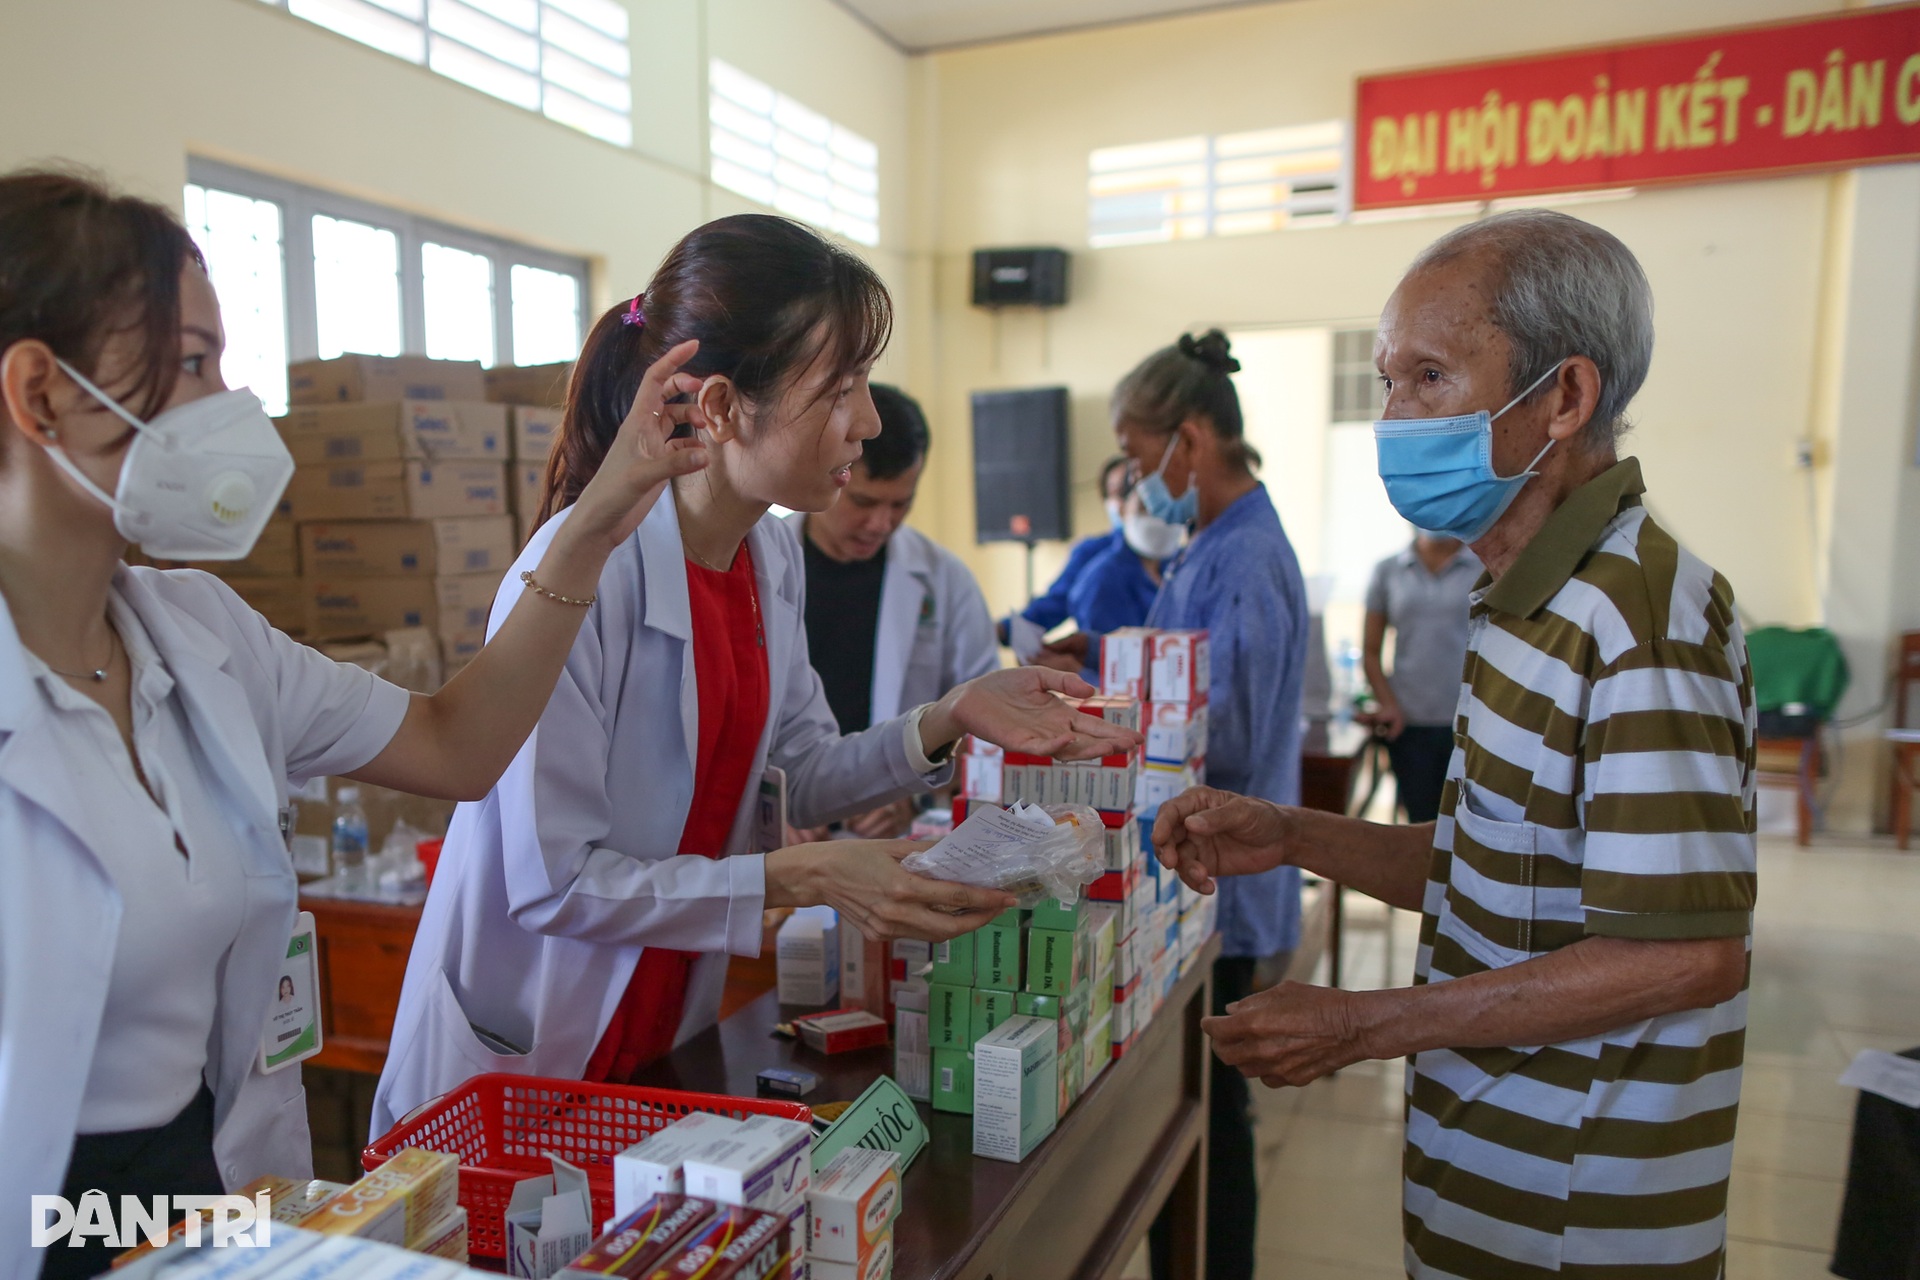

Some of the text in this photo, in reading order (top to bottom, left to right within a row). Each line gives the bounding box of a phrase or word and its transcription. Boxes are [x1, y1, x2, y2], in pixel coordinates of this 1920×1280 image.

[1368, 112, 1438, 196] ĐẠI
[1445, 89, 1519, 189] HỘI
[1655, 50, 1749, 150] KẾT
[1782, 48, 1886, 137] DÂN
[1044, 936, 1055, 974] Rotundin
